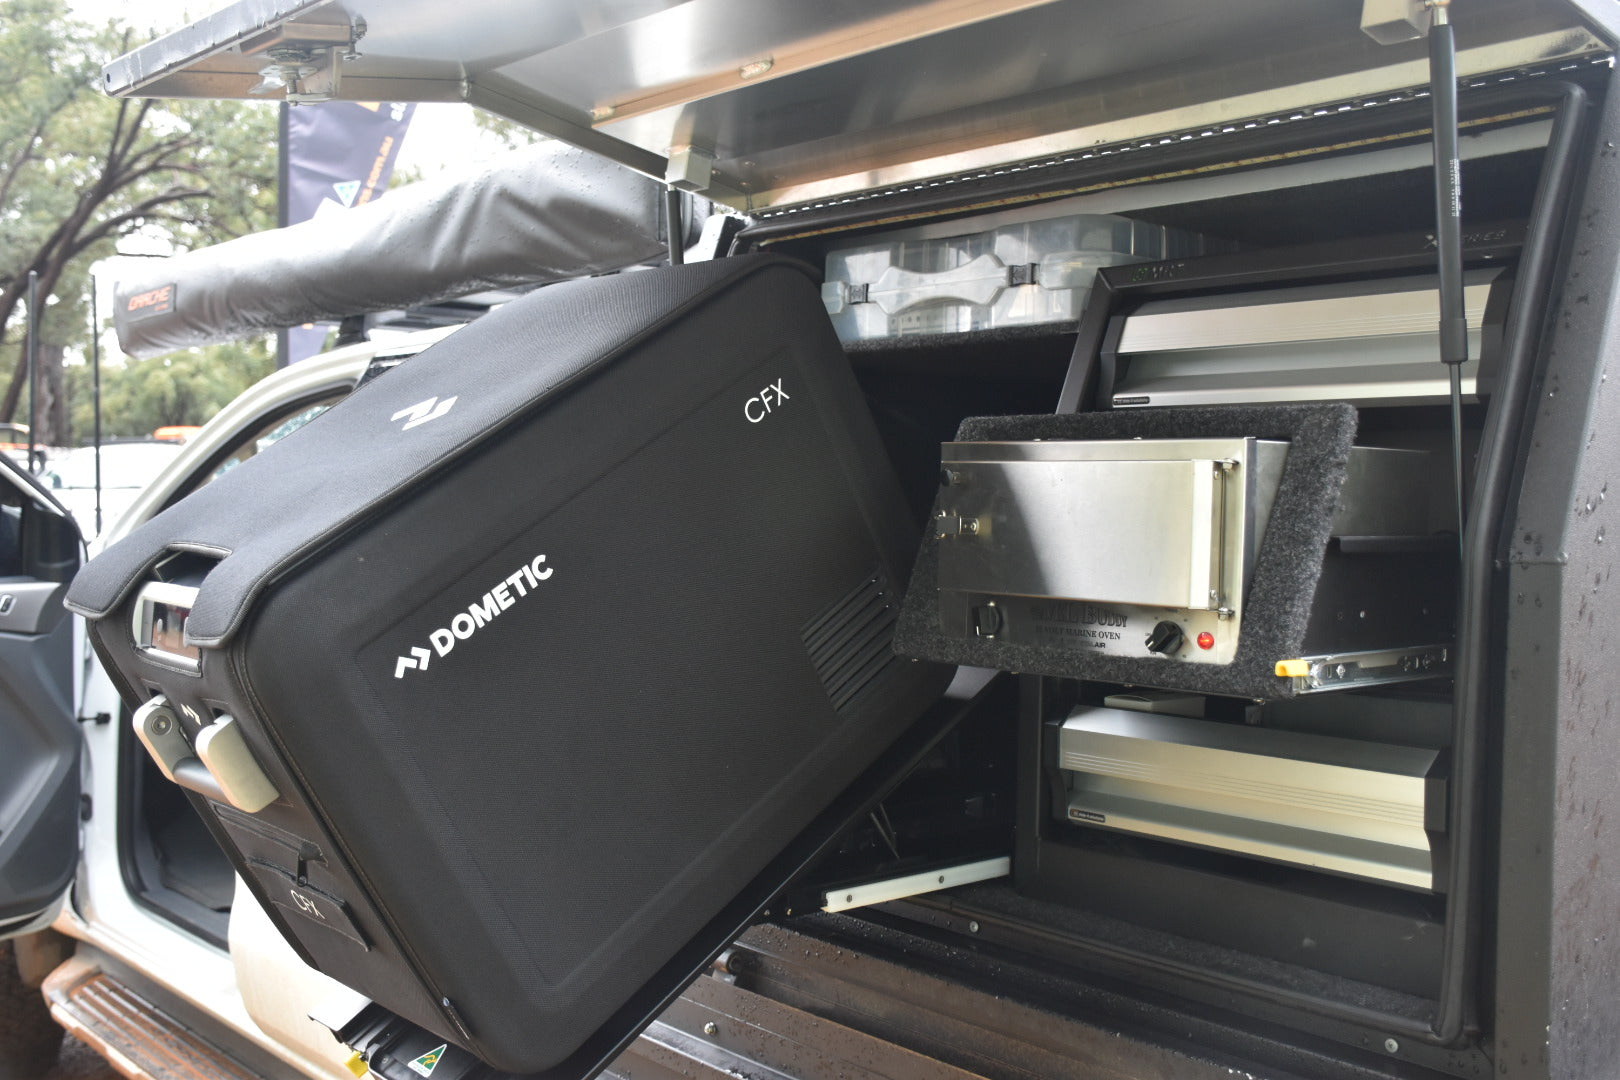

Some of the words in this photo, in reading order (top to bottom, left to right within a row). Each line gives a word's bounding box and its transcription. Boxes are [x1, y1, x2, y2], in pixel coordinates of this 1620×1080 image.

[745, 378, 790, 423] CFX
[429, 554, 554, 658] DOMETIC
[1081, 605, 1128, 627] BUDDY
[1065, 628, 1097, 638] MARINE
[1098, 631, 1121, 640] OVEN
[290, 889, 325, 919] CFX
